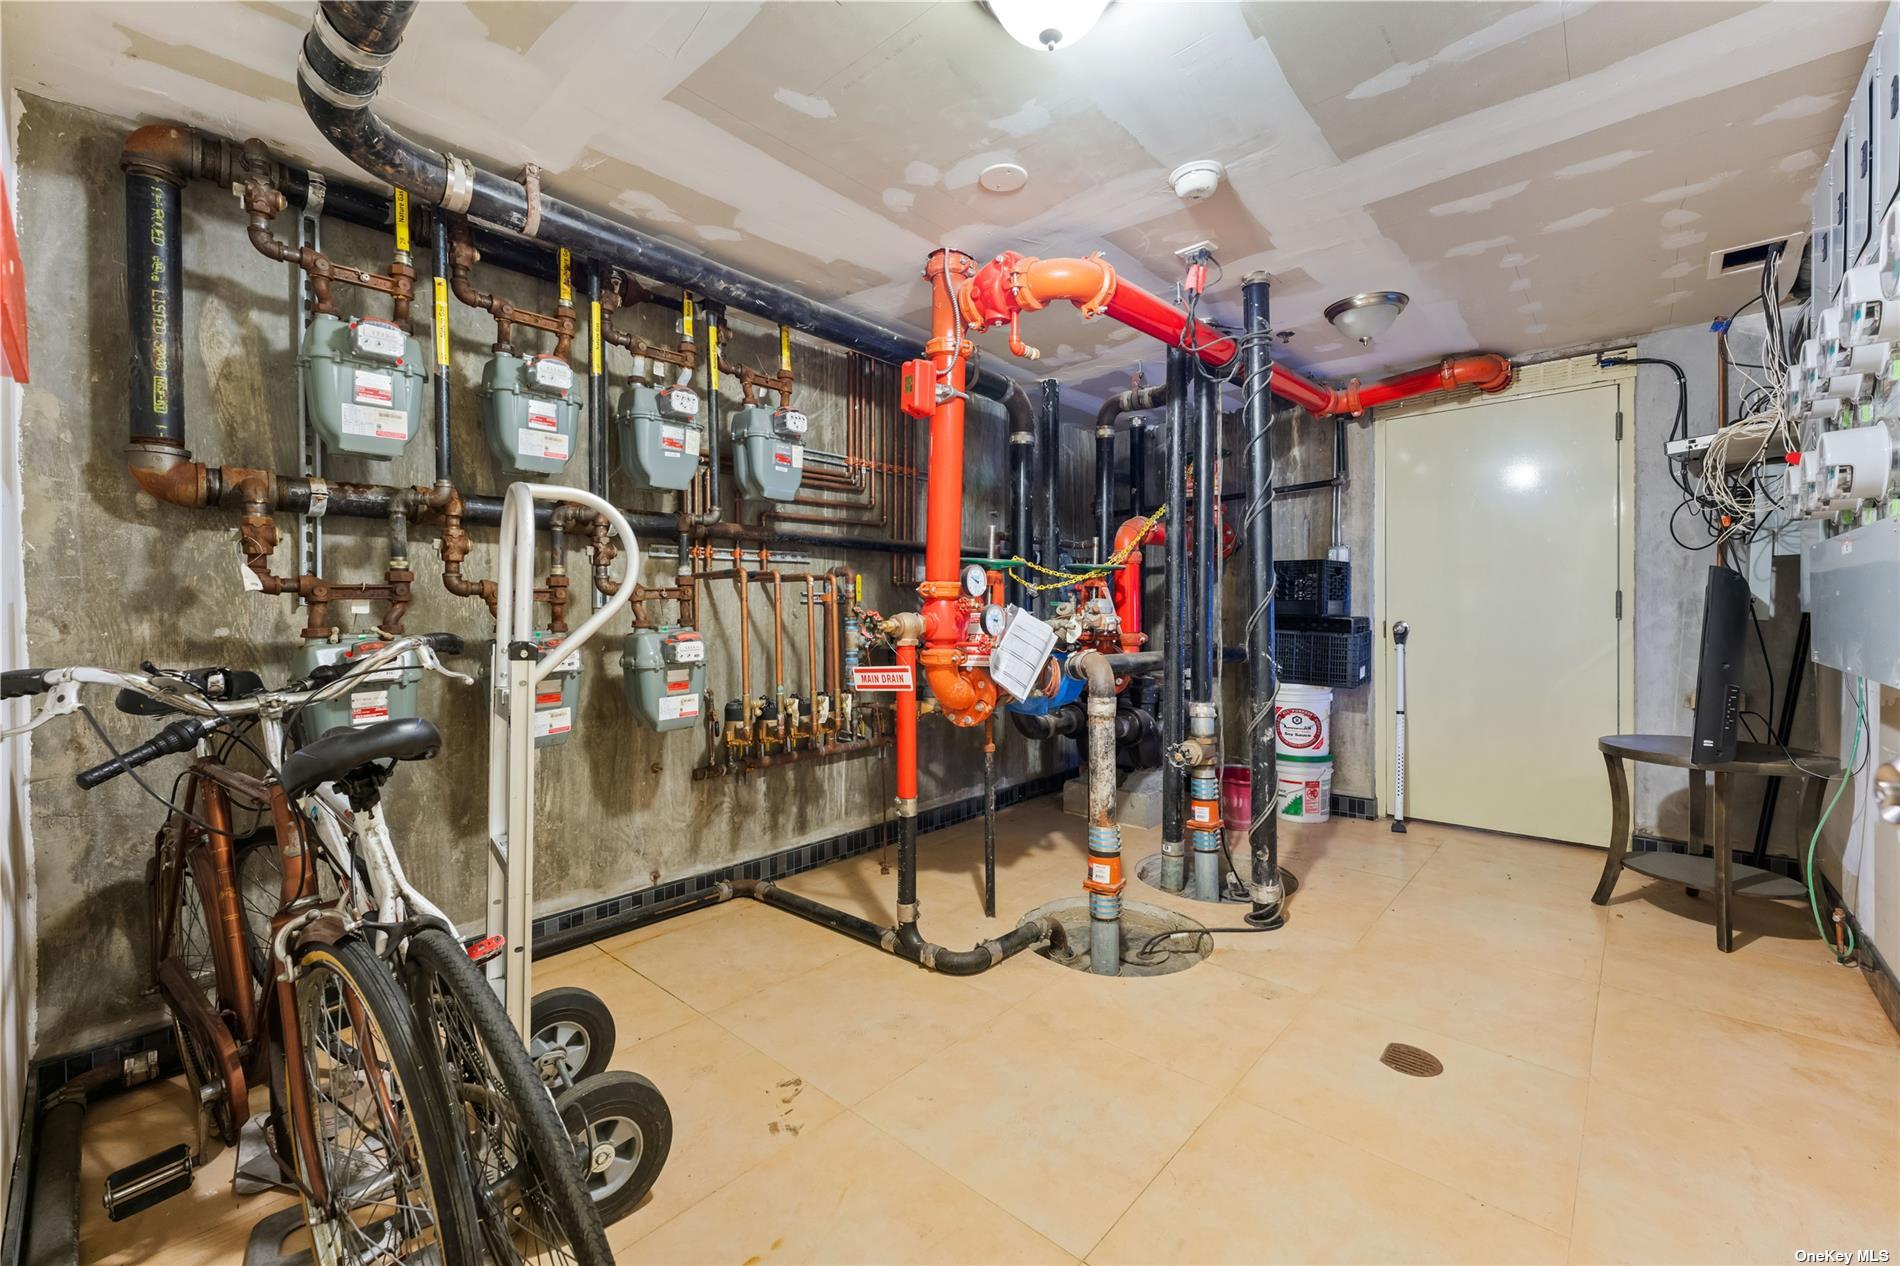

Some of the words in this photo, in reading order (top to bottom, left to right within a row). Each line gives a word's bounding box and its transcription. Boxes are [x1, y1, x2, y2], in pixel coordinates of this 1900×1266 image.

[152, 288, 168, 335] LISTED
[861, 674, 880, 684] MAIN
[881, 674, 905, 684] DRAIN
